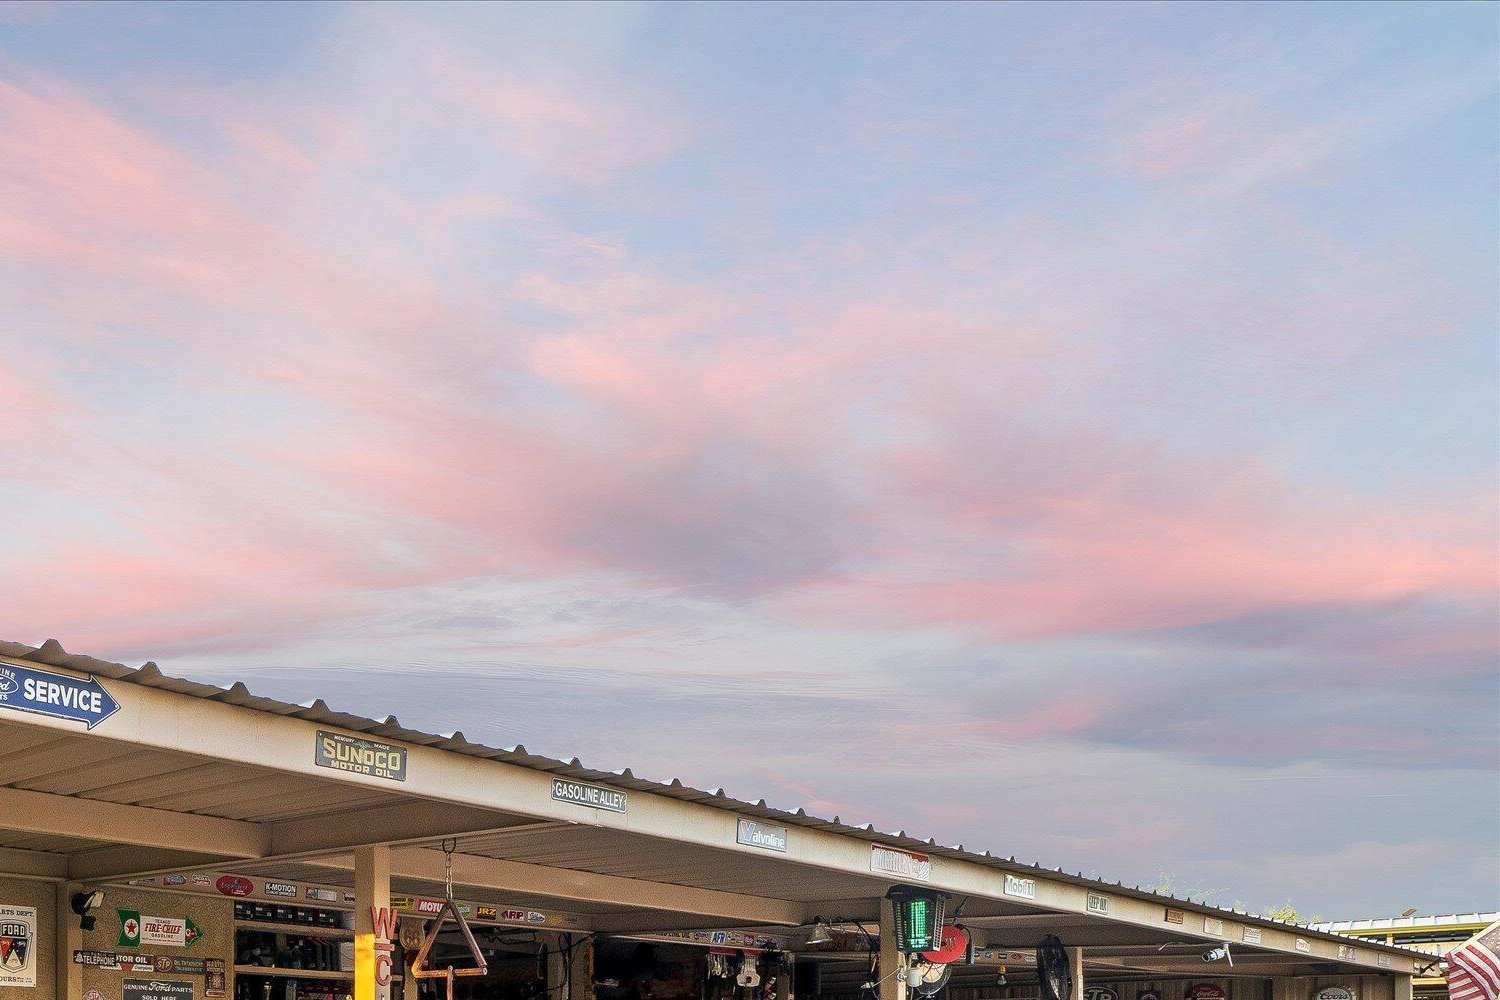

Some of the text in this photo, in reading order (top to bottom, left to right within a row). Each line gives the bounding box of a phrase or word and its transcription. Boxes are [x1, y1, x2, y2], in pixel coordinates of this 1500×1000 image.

[23, 679, 102, 713] SERVICE
[323, 738, 401, 771] SUNOCO
[331, 760, 394, 778] MOTOR OIL
[555, 782, 624, 808] GASOLINE ALLEY
[740, 820, 785, 848] Valvoline
[266, 882, 296, 893] K-MOTION
[419, 901, 444, 913] MOTU
[477, 907, 497, 916] JRZ
[16, 910, 35, 918] DEPT.
[2, 924, 25, 936] FORD
[144, 923, 182, 934] FIRE-CHIEF
[83, 955, 115, 966] TELEPHONE
[135, 956, 148, 964] OIL
[157, 958, 171, 970] STP
[124, 983, 148, 991] GENUINE
[149, 981, 172, 992] Ford
[1320, 992, 1348, 1000] Coors
